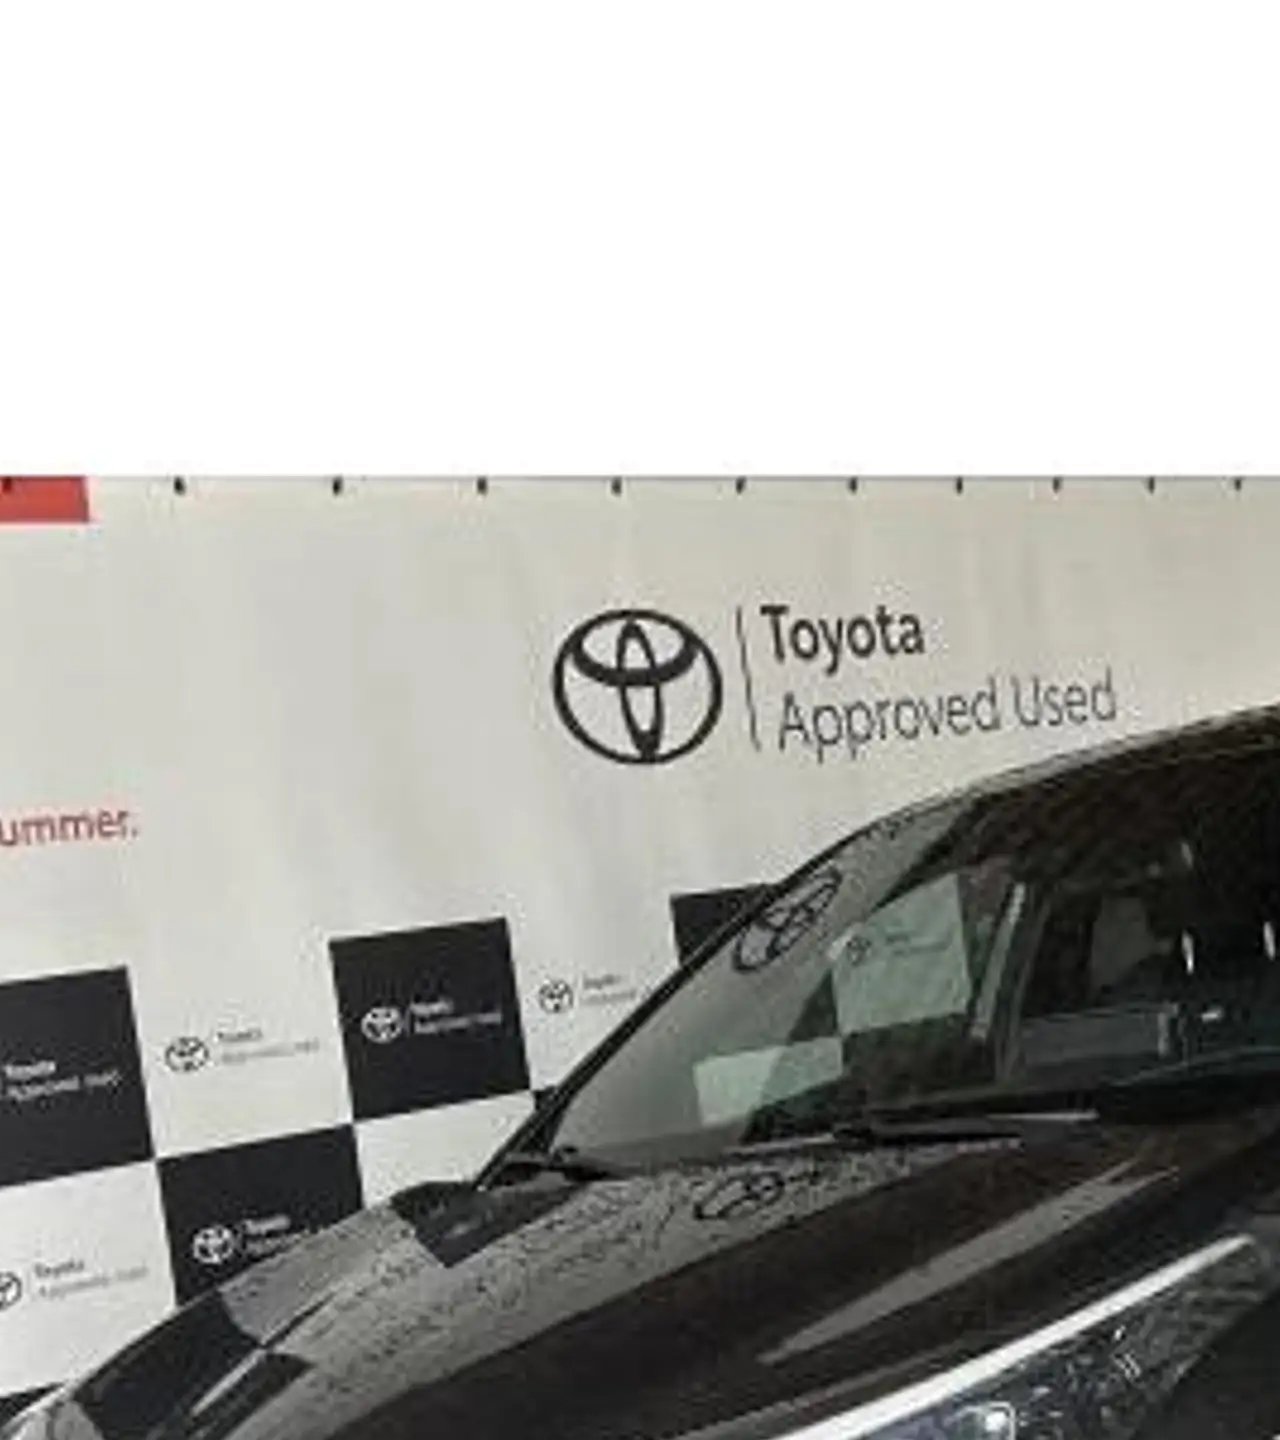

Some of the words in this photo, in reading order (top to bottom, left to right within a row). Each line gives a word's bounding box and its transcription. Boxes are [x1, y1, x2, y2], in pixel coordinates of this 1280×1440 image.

[760, 603, 925, 676] Toyota
[778, 677, 1001, 763] Approved
[1011, 664, 1117, 728] Used
